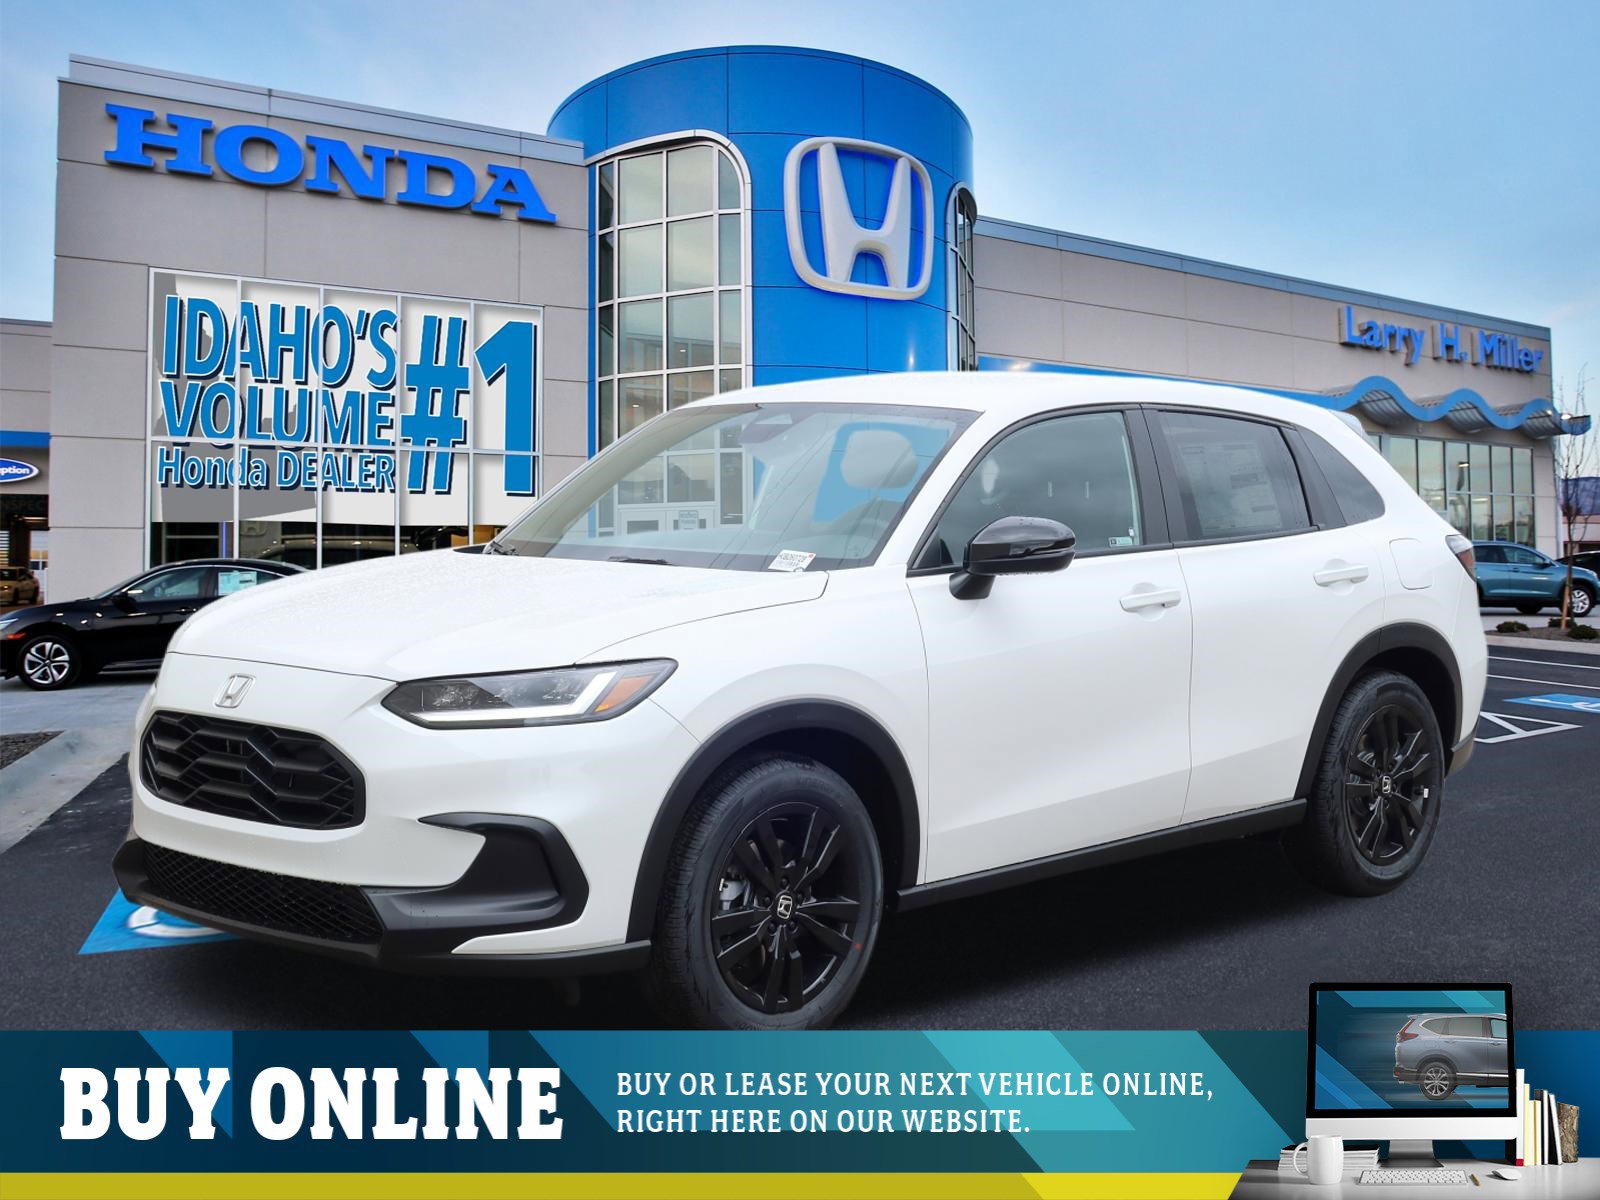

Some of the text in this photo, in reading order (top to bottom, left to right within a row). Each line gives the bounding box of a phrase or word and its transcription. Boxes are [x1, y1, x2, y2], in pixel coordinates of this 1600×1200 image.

[104, 103, 557, 224] HONDA
[162, 294, 399, 390] IDAHO'S
[1342, 304, 1545, 373] Larry H. Miller
[159, 379, 396, 451] VOLUME
[400, 314, 537, 497] #1
[156, 446, 396, 494] Honda DEALER
